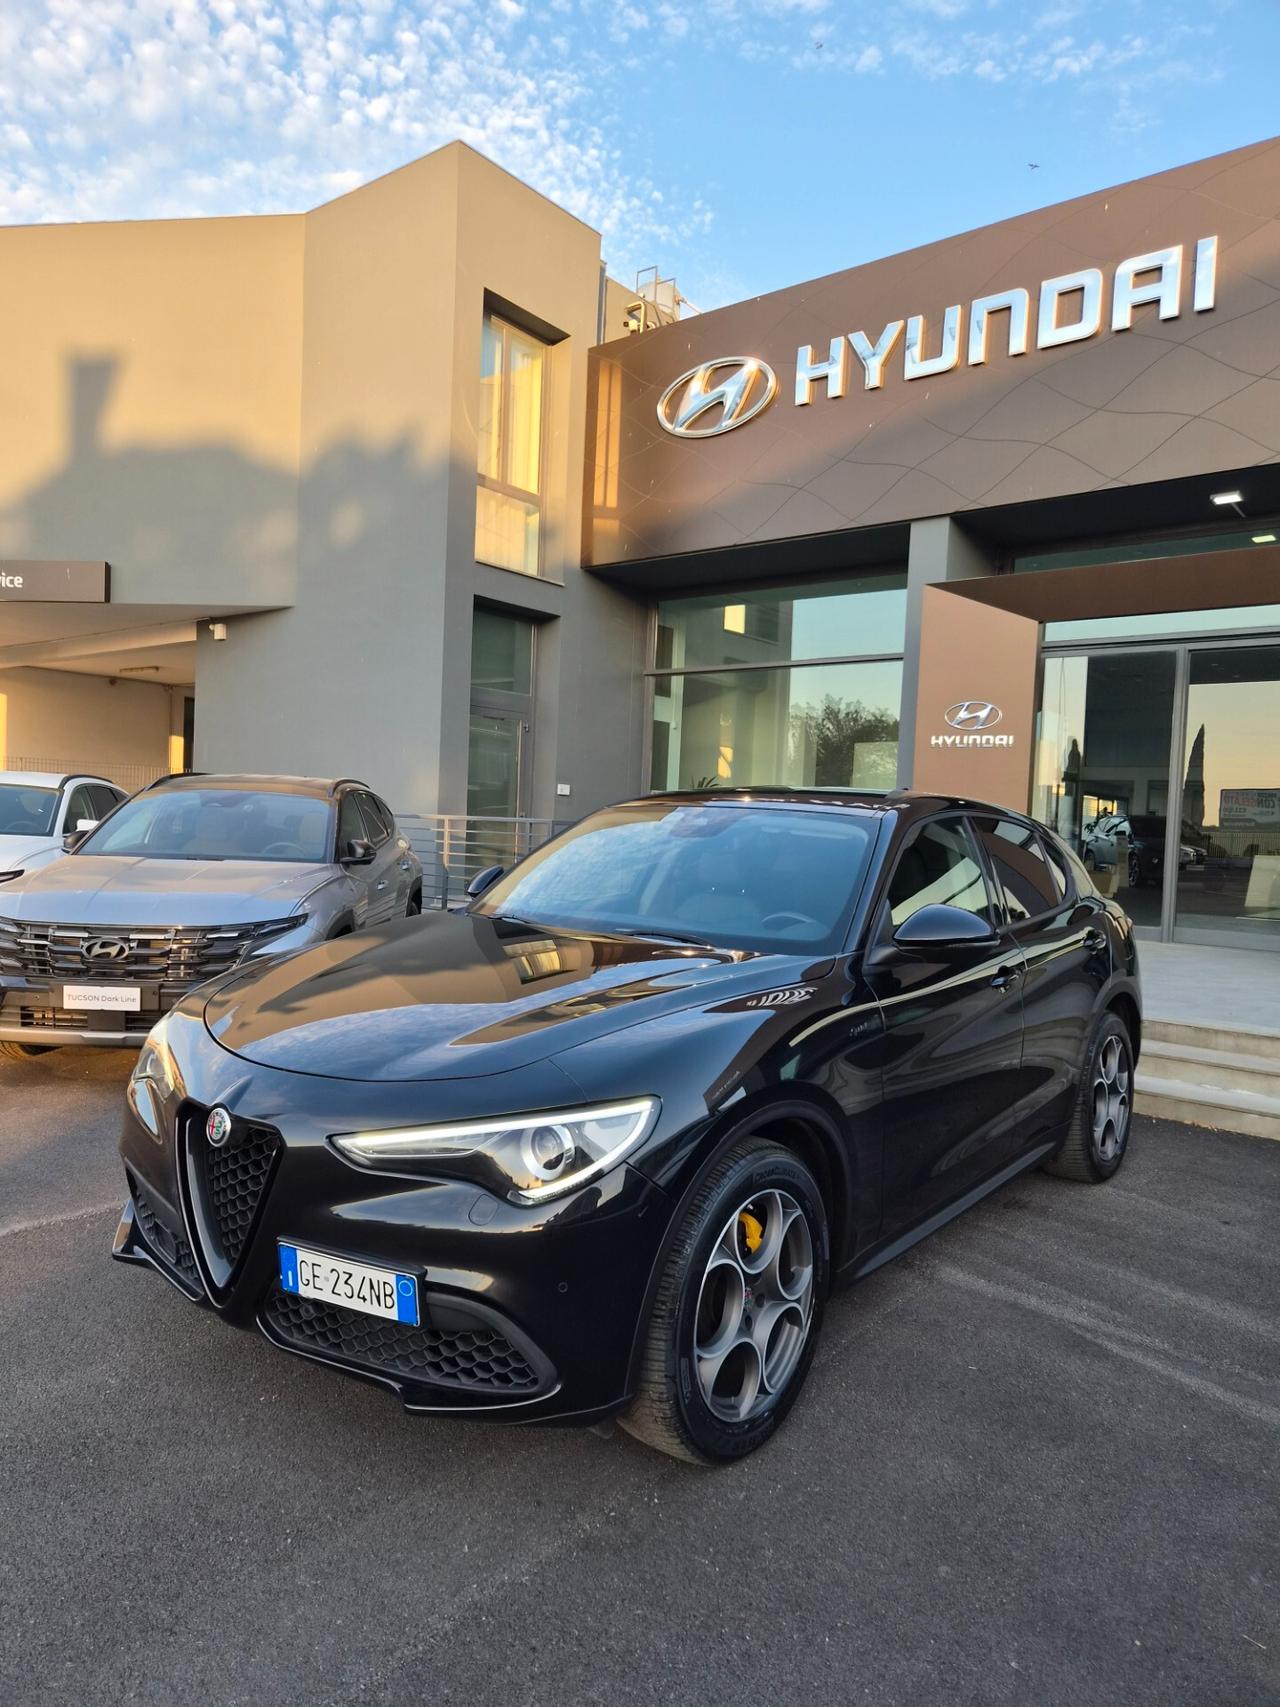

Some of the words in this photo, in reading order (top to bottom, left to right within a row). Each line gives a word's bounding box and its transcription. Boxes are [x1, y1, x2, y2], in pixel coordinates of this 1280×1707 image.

[795, 236, 1218, 407] HYUNDAI
[930, 735, 1014, 748] HYUNDAI
[67, 994, 99, 1002] TUCSON
